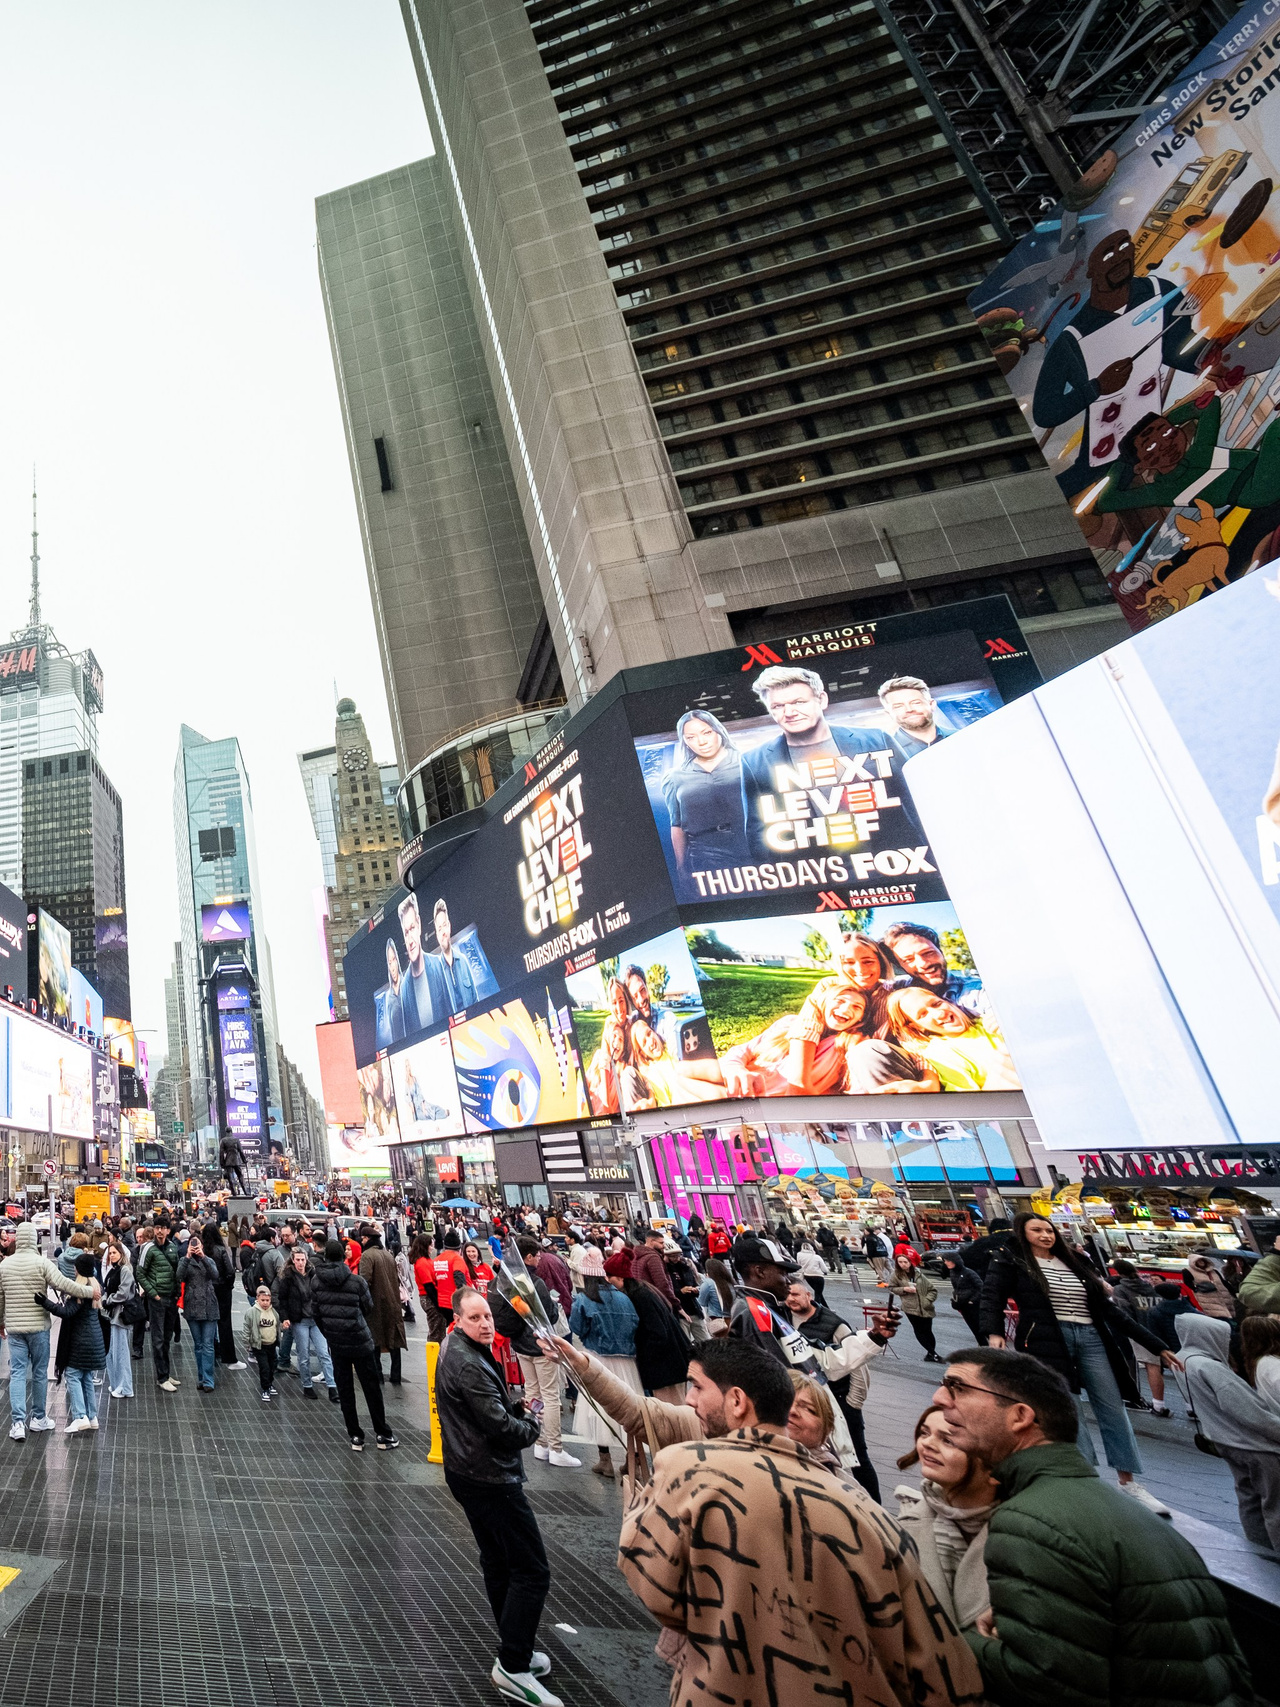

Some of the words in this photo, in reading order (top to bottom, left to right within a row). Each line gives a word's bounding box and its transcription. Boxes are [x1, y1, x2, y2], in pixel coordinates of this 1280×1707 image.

[1135, 108, 1171, 147] CHRIS
[1171, 71, 1208, 110] ROCK
[1217, 14, 1261, 61] TERRY
[1150, 112, 1204, 168] New
[786, 623, 877, 648] MARRIOTT
[790, 636, 871, 659] MARQUIS
[992, 651, 1029, 661] MARRIOTT
[536, 730, 565, 761] MARRIOTT
[538, 742, 564, 772] MARQUIS
[774, 750, 895, 793] NEXT
[521, 773, 585, 856] NEXT
[760, 779, 901, 823] LEVEL
[401, 834, 424, 857] MARRIOTT
[765, 810, 880, 851] CHEF
[518, 820, 593, 900] LEVEL
[692, 855, 850, 897] THURSDAYS
[851, 846, 937, 880] FOX
[525, 866, 584, 936] CHEF
[849, 884, 917, 898] MARRIOTT
[851, 893, 912, 906] MARQUIS
[523, 932, 571, 973] THURSDAYS
[568, 918, 597, 950] FOX
[605, 911, 631, 933] hulu
[227, 1021, 246, 1031] HIRE
[590, 1119, 613, 1128] SEPHORA
[588, 1167, 630, 1180] SEPHORA
